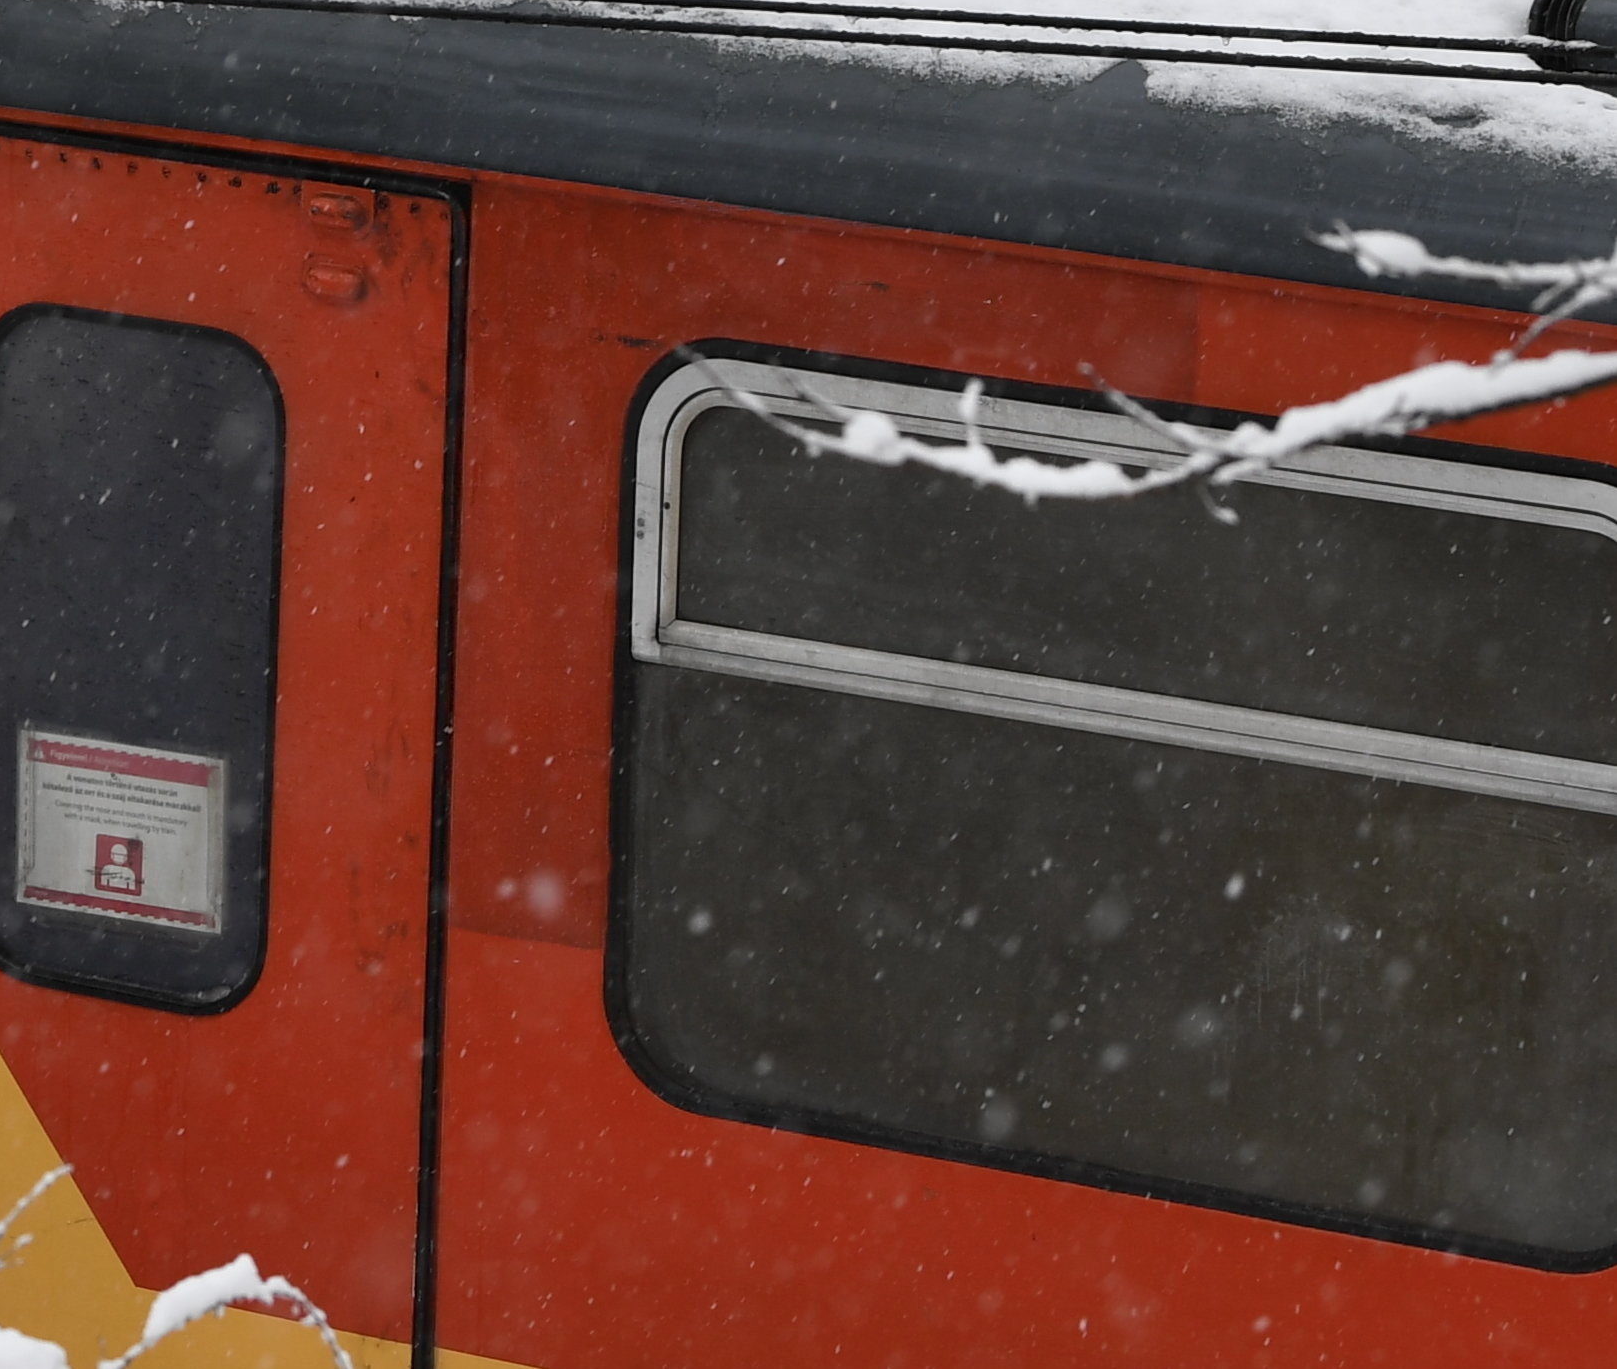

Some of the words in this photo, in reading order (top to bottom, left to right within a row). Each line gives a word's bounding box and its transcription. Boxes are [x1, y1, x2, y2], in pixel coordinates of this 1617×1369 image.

[133, 782, 156, 794] utazás
[158, 786, 178, 797] során
[84, 803, 95, 812] the
[95, 806, 111, 814] nose
[112, 808, 124, 816] and
[125, 809, 145, 818] mouth
[102, 817, 120, 826] when
[152, 824, 160, 834] by
